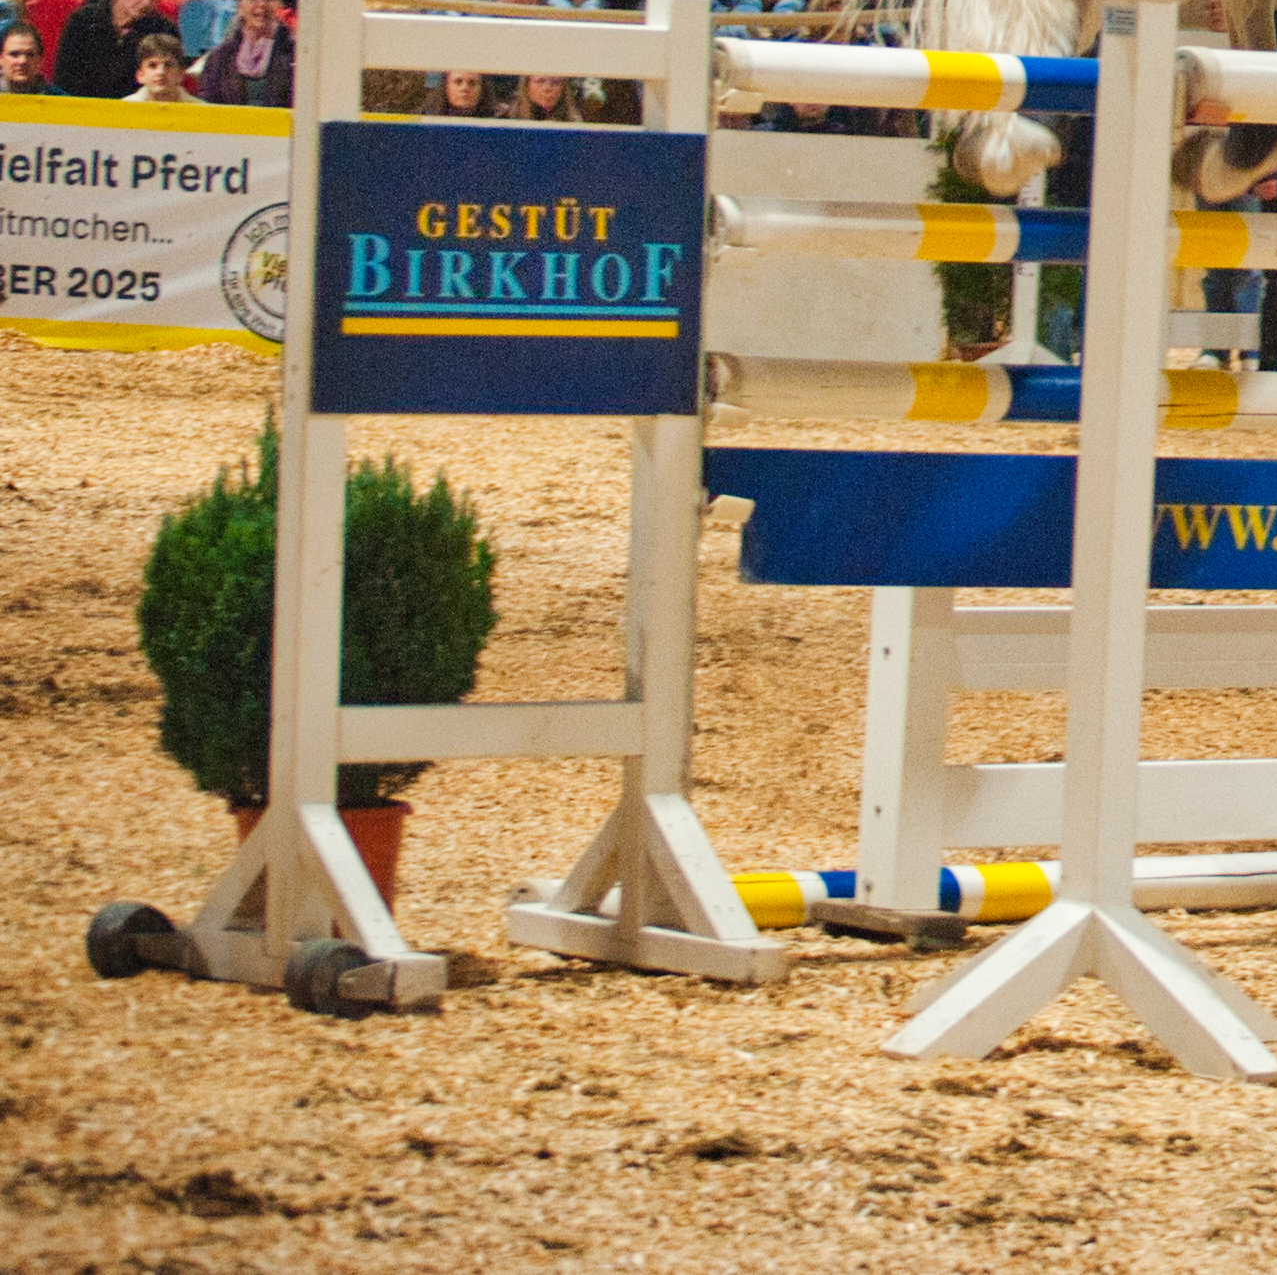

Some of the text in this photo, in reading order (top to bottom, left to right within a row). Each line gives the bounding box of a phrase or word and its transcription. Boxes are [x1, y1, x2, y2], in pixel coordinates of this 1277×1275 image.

[131, 152, 249, 195] Pferd
[416, 197, 617, 241] GESTÜT
[0, 263, 163, 303] ER 2025
[345, 233, 684, 302] BIRKHOF
